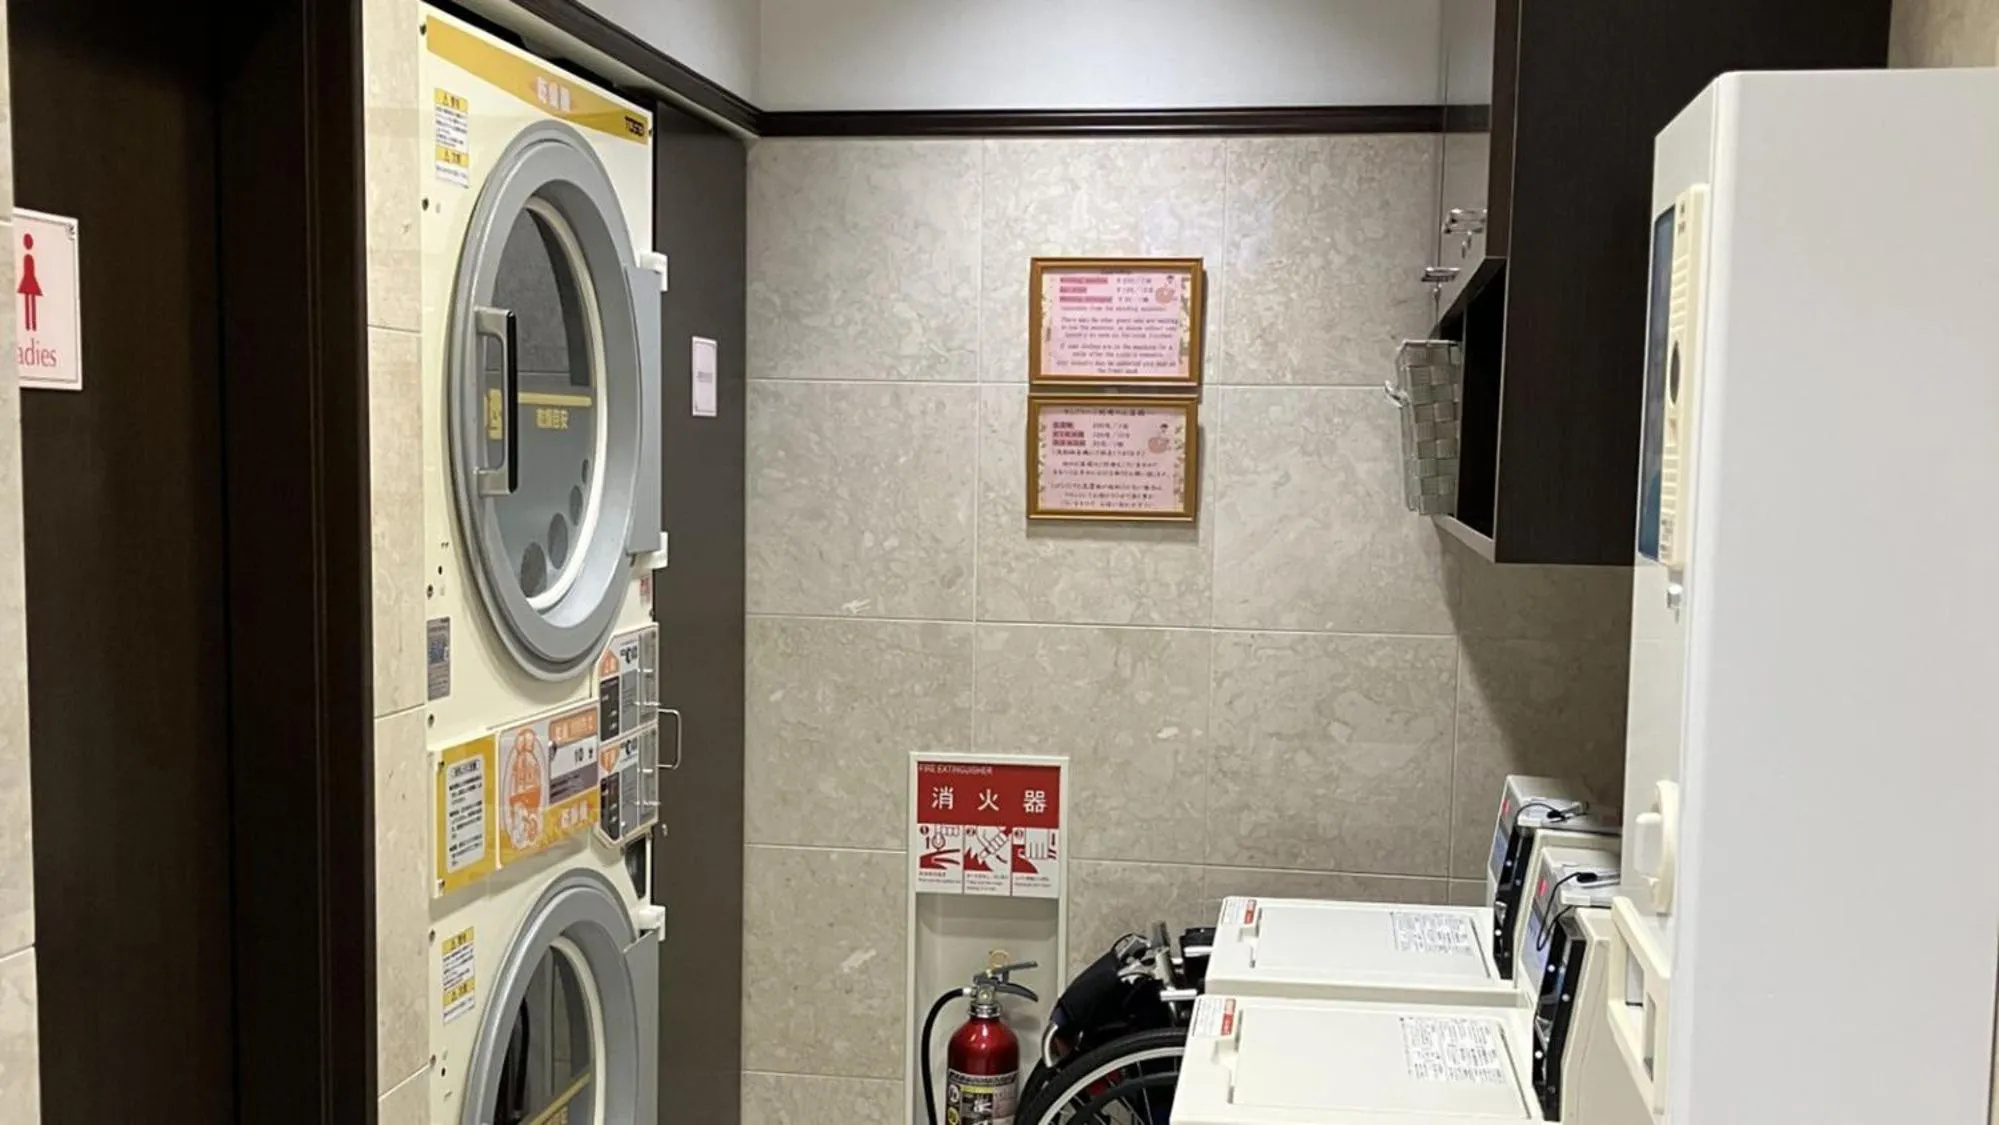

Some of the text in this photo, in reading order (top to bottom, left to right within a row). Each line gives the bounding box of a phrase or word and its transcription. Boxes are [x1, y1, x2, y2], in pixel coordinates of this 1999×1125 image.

[937, 765, 993, 775] EXTINGUISHER
[931, 785, 1047, 813] 消火器
